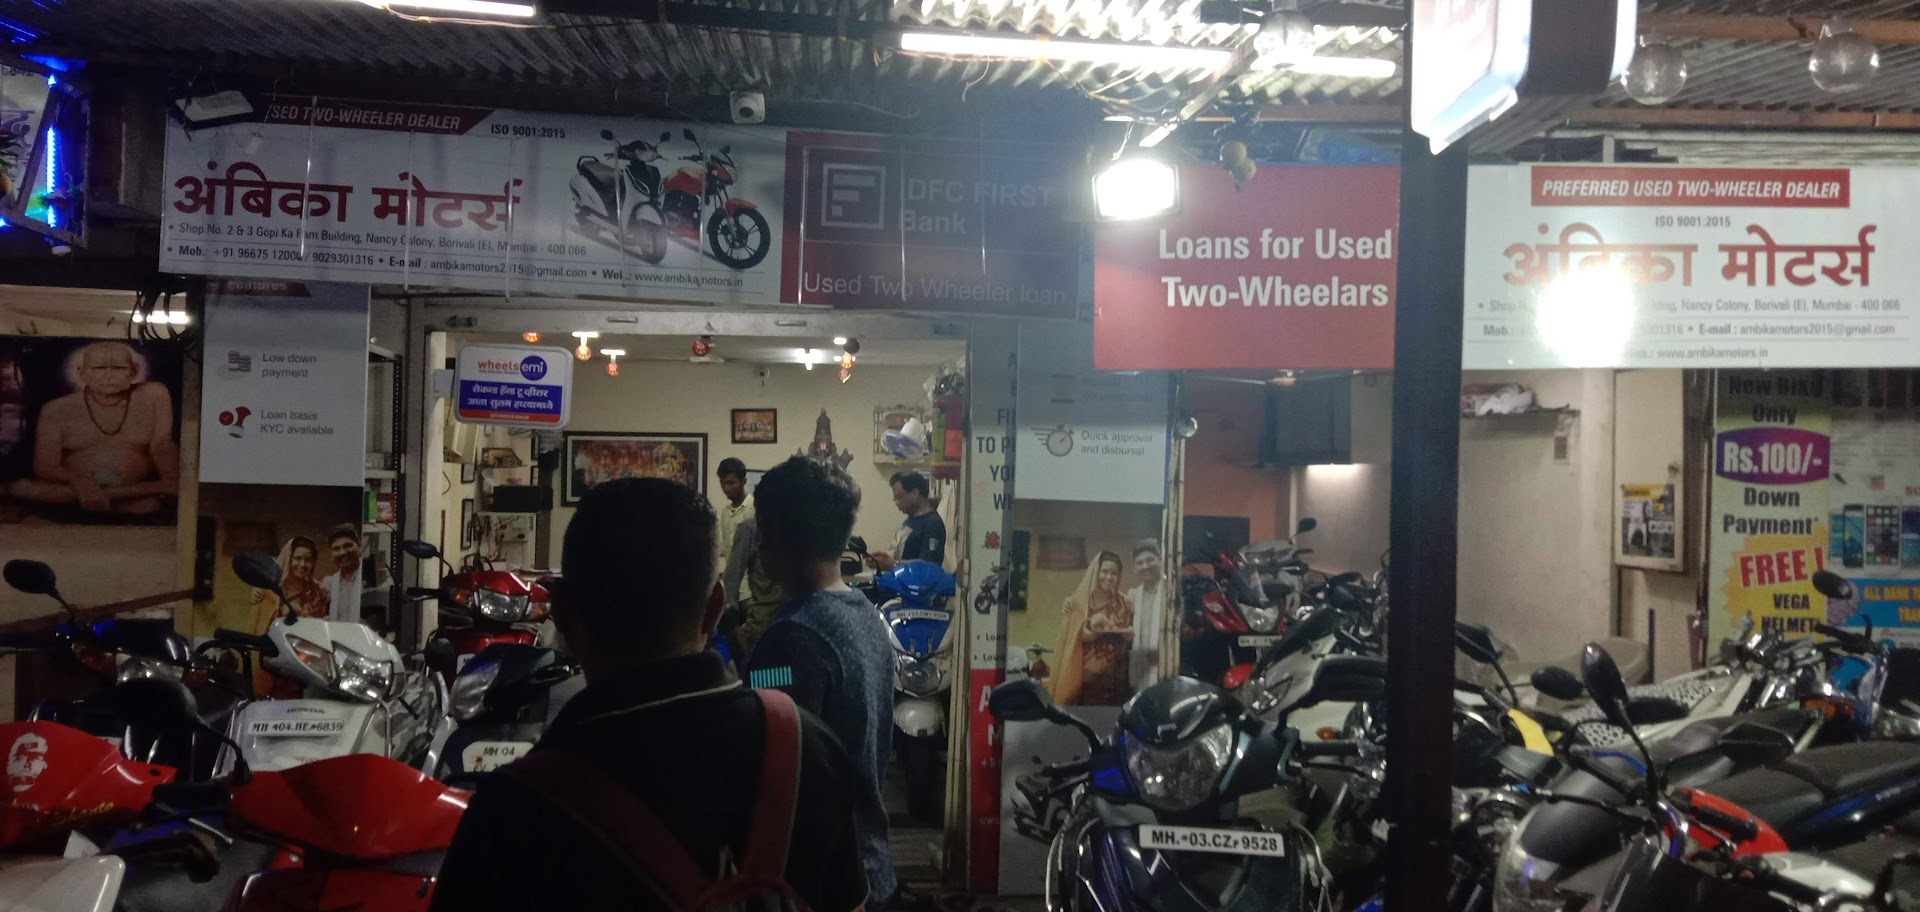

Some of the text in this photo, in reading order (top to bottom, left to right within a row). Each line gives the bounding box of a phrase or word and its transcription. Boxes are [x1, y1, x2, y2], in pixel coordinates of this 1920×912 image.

[270, 103, 461, 131] SED TWO-WHEELER DEALER
[491, 123, 566, 139] ISO 9001:2015
[173, 160, 523, 232] अंबिका मोटर्स
[901, 177, 964, 203] DFC
[1542, 179, 1840, 199] PREFERRED USED TWO-WHEELER DEALER
[899, 208, 967, 235] Bank
[1655, 216, 1731, 228] ISO 9001:2015
[179, 222, 204, 236] Shop
[207, 224, 223, 235] No.
[227, 225, 233, 236] 2
[236, 226, 244, 236] &
[247, 226, 253, 237] 3
[256, 226, 278, 239] Gopi
[281, 228, 293, 238] Ka
[321, 230, 362, 244] Building,
[366, 232, 397, 246] Nancy
[547, 243, 566, 255] 400
[568, 244, 587, 256] 066
[1159, 228, 1392, 260] Loans for Used
[213, 247, 234, 258] +91
[238, 248, 268, 259] 96675
[312, 251, 374, 266] 9029301316
[430, 260, 587, 278] ambikamotors215@gmail.com
[1719, 224, 1878, 288] मोटर्स
[804, 271, 1066, 304] Used Two Wheeler loan
[1161, 275, 1390, 307] Two-Wheelars
[1682, 300, 1713, 312] Nancy
[1715, 300, 1751, 312] Colony,
[1812, 300, 1852, 311] Mumbai
[1861, 300, 1880, 311] 400
[1699, 323, 1731, 335] E-mail
[262, 353, 317, 364] Low down
[262, 368, 308, 379] payment
[260, 409, 318, 421] Loan basis
[260, 423, 334, 435] KYC available
[1081, 430, 1152, 443] Quick approval
[976, 437, 996, 454] TO
[1081, 445, 1144, 456] and disbursal
[1722, 441, 1823, 476] Rs.100/-
[1743, 487, 1800, 507] Down
[1739, 548, 1810, 589] FREE
[1773, 593, 1811, 609] VEGA
[483, 746, 515, 756] MH 04
